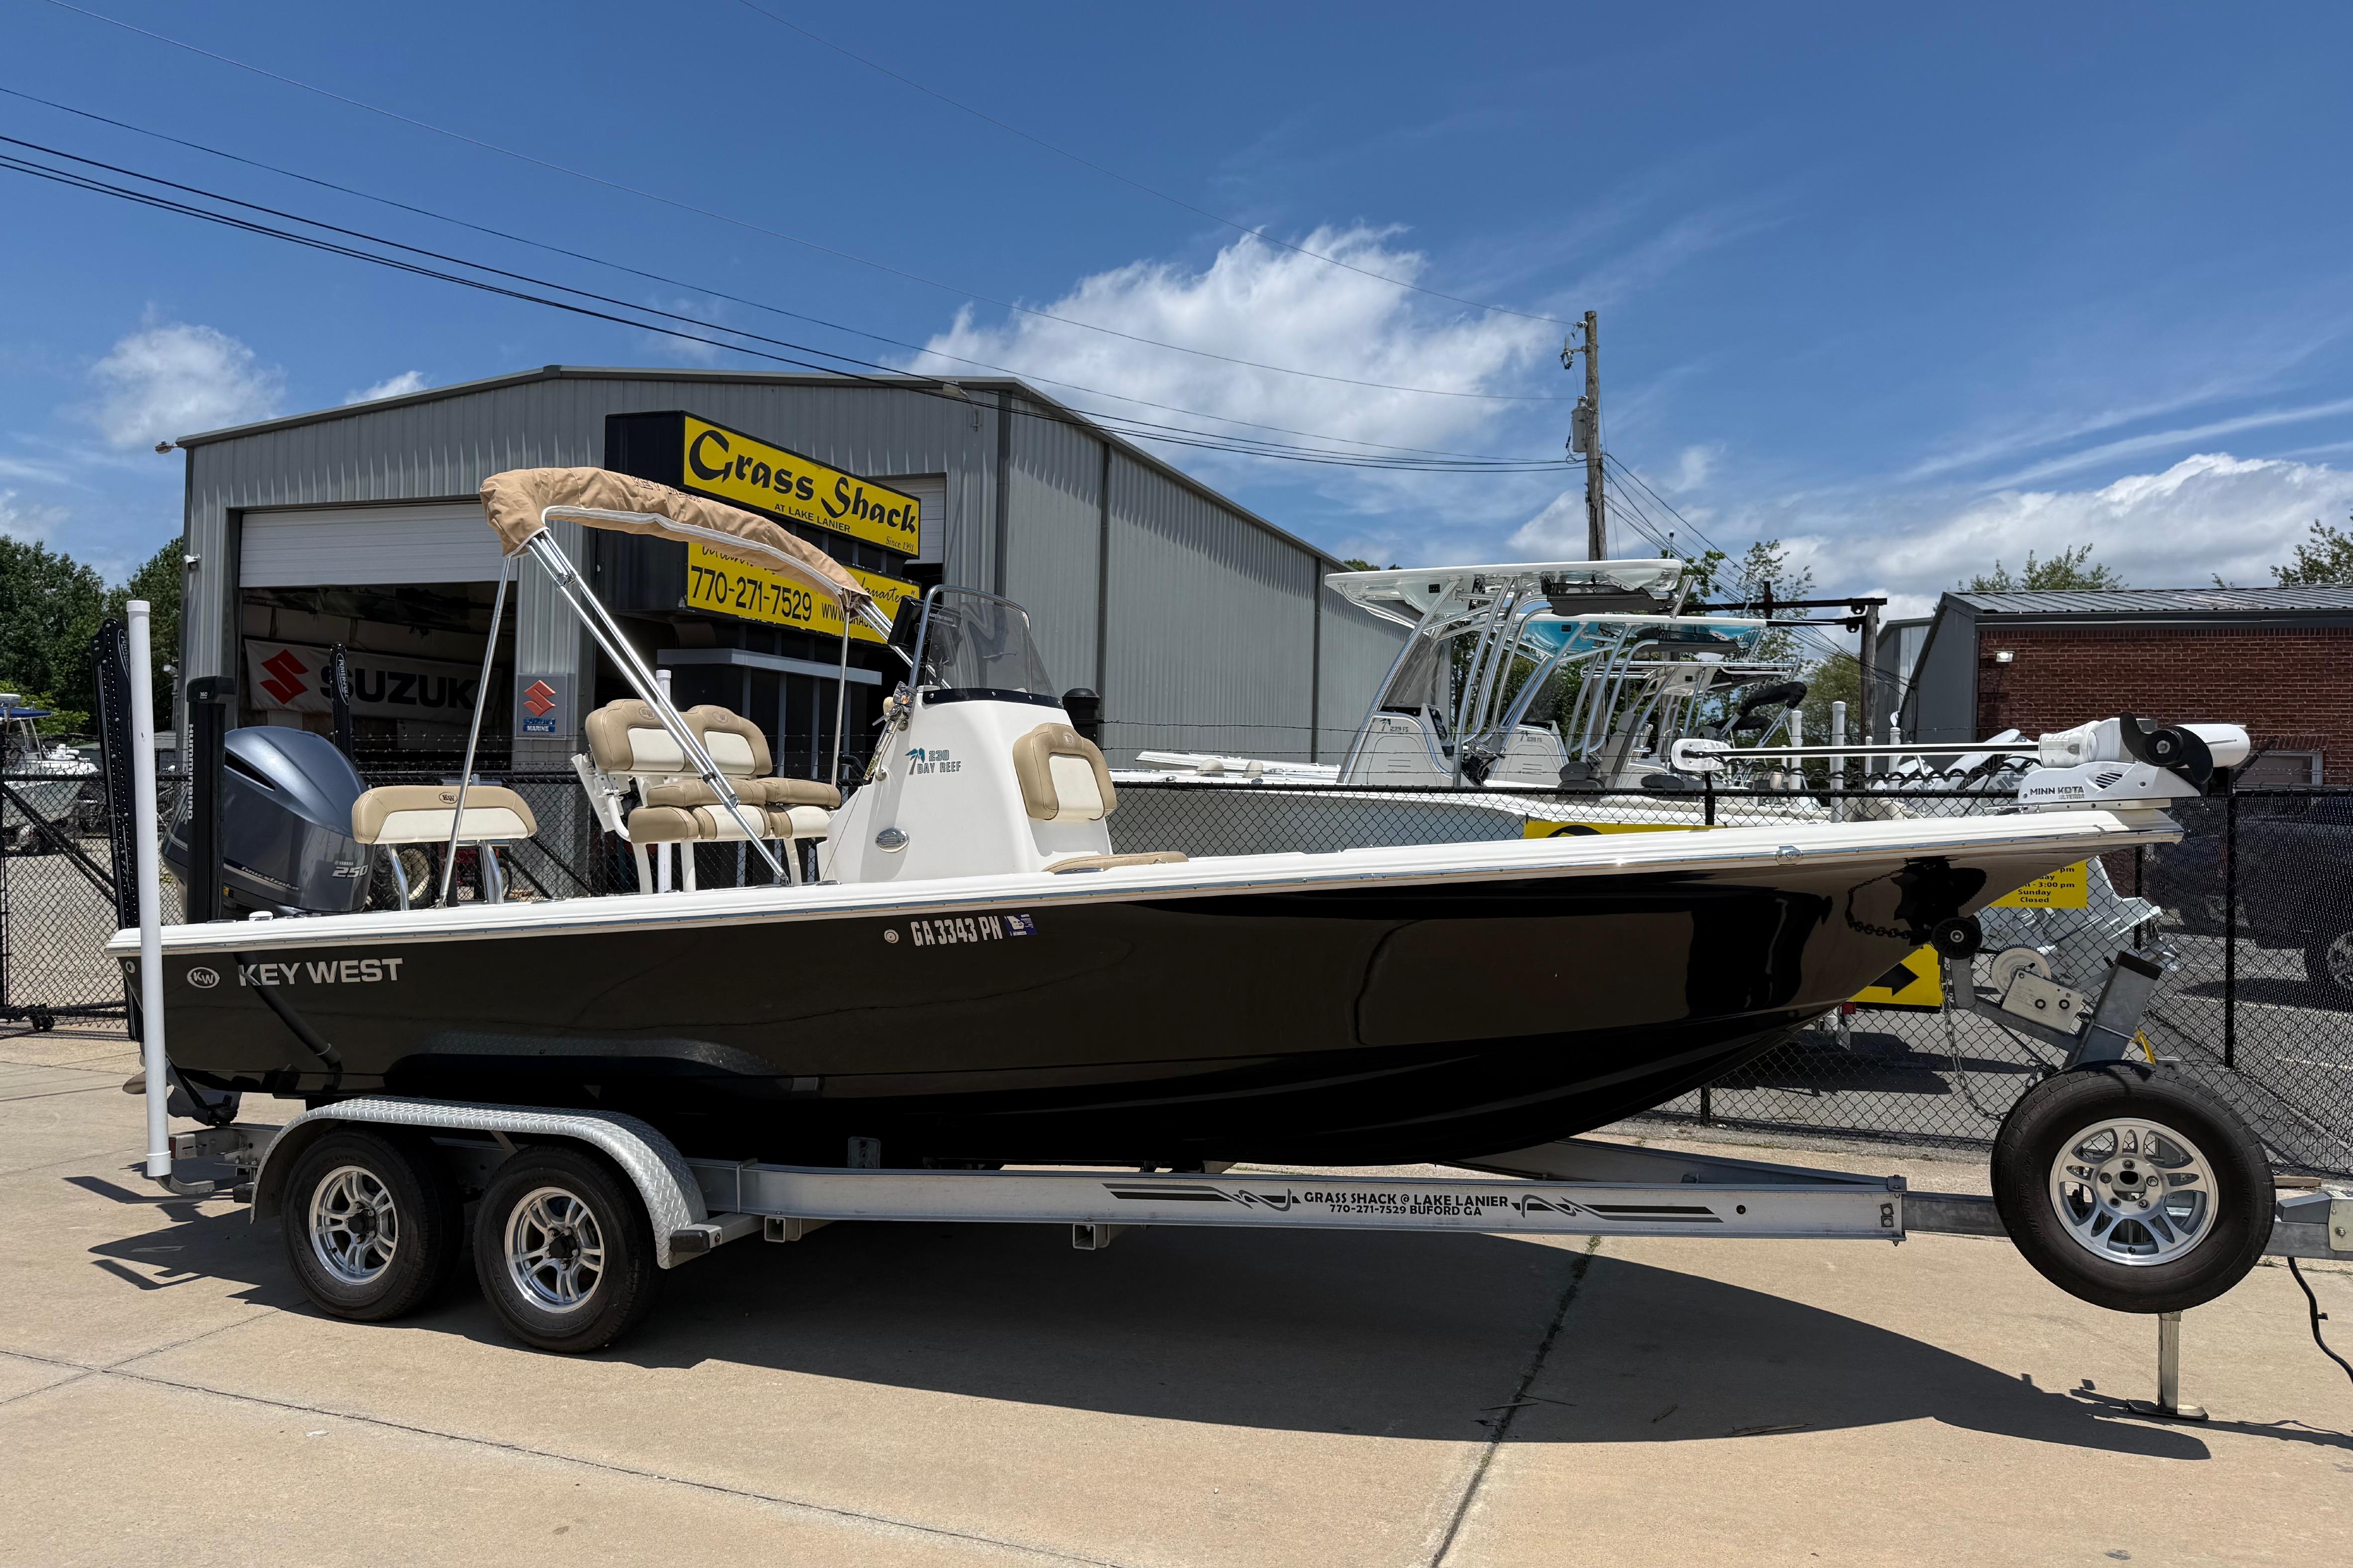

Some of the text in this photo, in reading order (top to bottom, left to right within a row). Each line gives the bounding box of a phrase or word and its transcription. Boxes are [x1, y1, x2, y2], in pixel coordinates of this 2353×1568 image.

[689, 430, 916, 534] Grass Shack
[774, 503, 851, 533] AT LAKE LANIER
[886, 536, 914, 552] Since 1991
[691, 565, 812, 622] 770-271-7529
[320, 666, 488, 710] SUZUK
[928, 749, 950, 762] 230
[917, 761, 961, 774] BAY REEF
[2030, 787, 2055, 795] MINN
[332, 865, 369, 878] 250
[910, 920, 936, 947] GA
[934, 918, 978, 944] 3343
[978, 916, 1003, 941] PN
[238, 958, 404, 986] KEY WEST
[1304, 1191, 1509, 1207] GRASS SHACK @ LAKE LANIER
[1330, 1204, 1482, 1216] 770-271-7529 BUFORD GA
